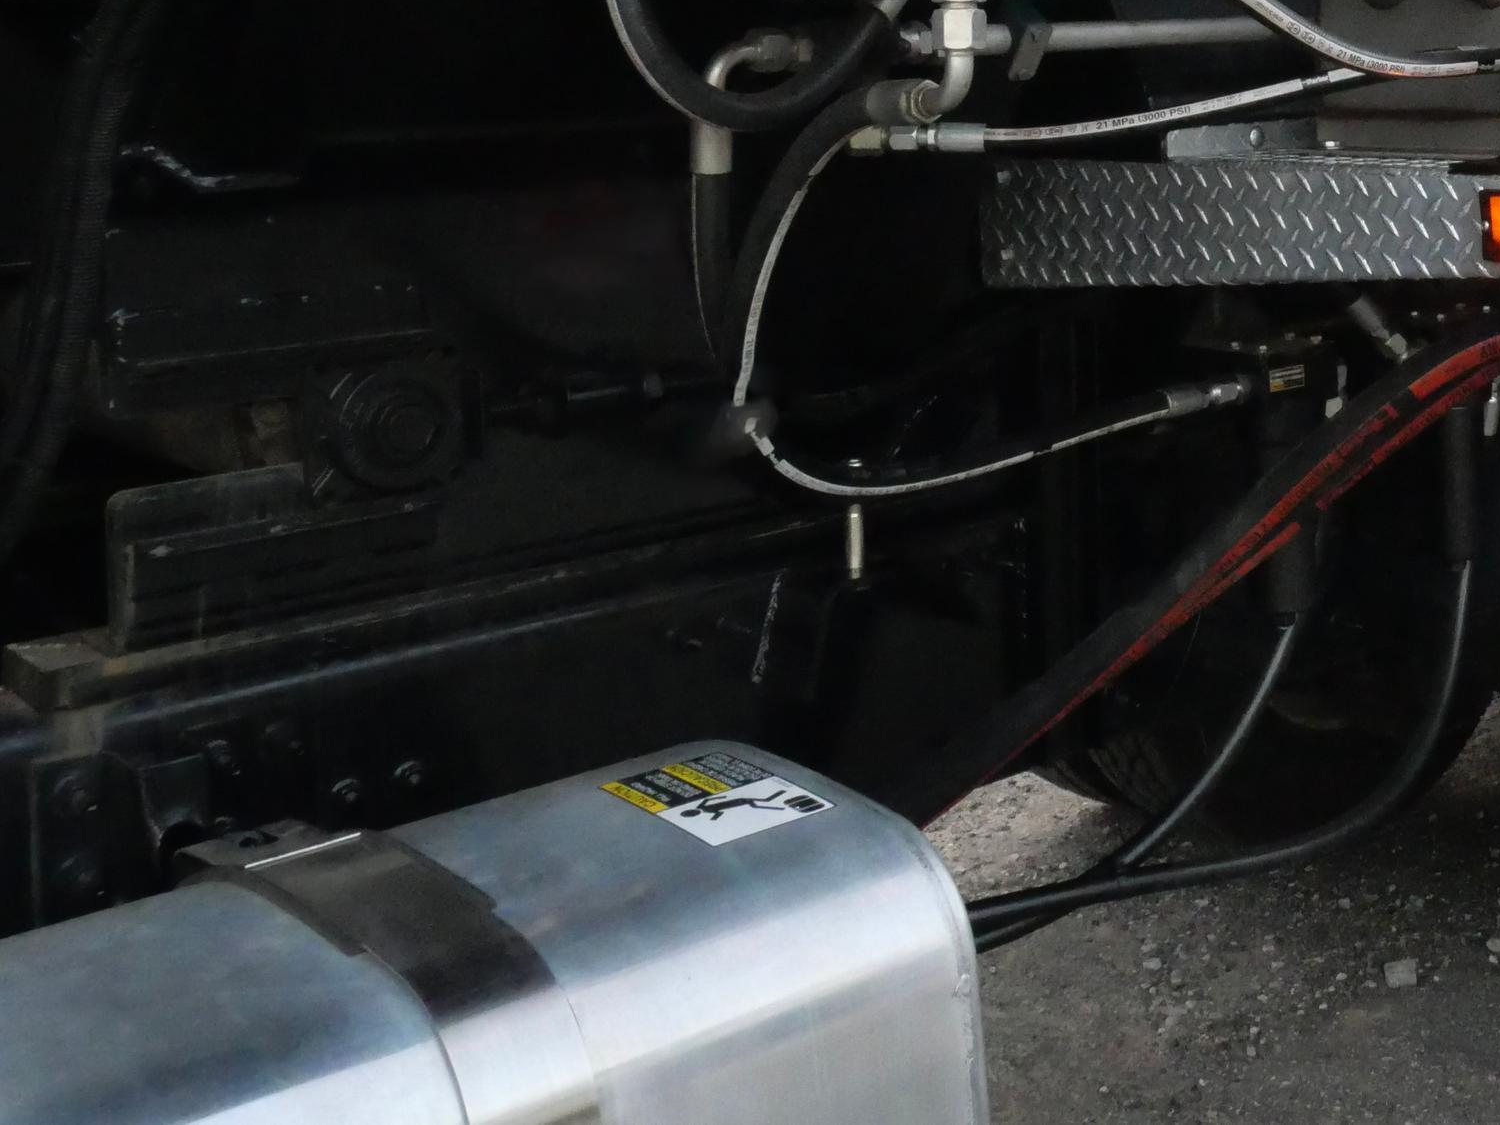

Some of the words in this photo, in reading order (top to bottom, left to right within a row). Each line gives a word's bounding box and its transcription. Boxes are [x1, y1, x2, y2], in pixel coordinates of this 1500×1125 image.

[1336, 49, 1347, 60] 21
[1348, 52, 1365, 67] MPa
[1366, 58, 1389, 73] (3000
[1389, 63, 1406, 74] PSI)
[1095, 121, 1108, 130] 21
[1112, 117, 1134, 128] MPa
[1138, 110, 1166, 123] (3000
[1169, 105, 1191, 118] PSI)
